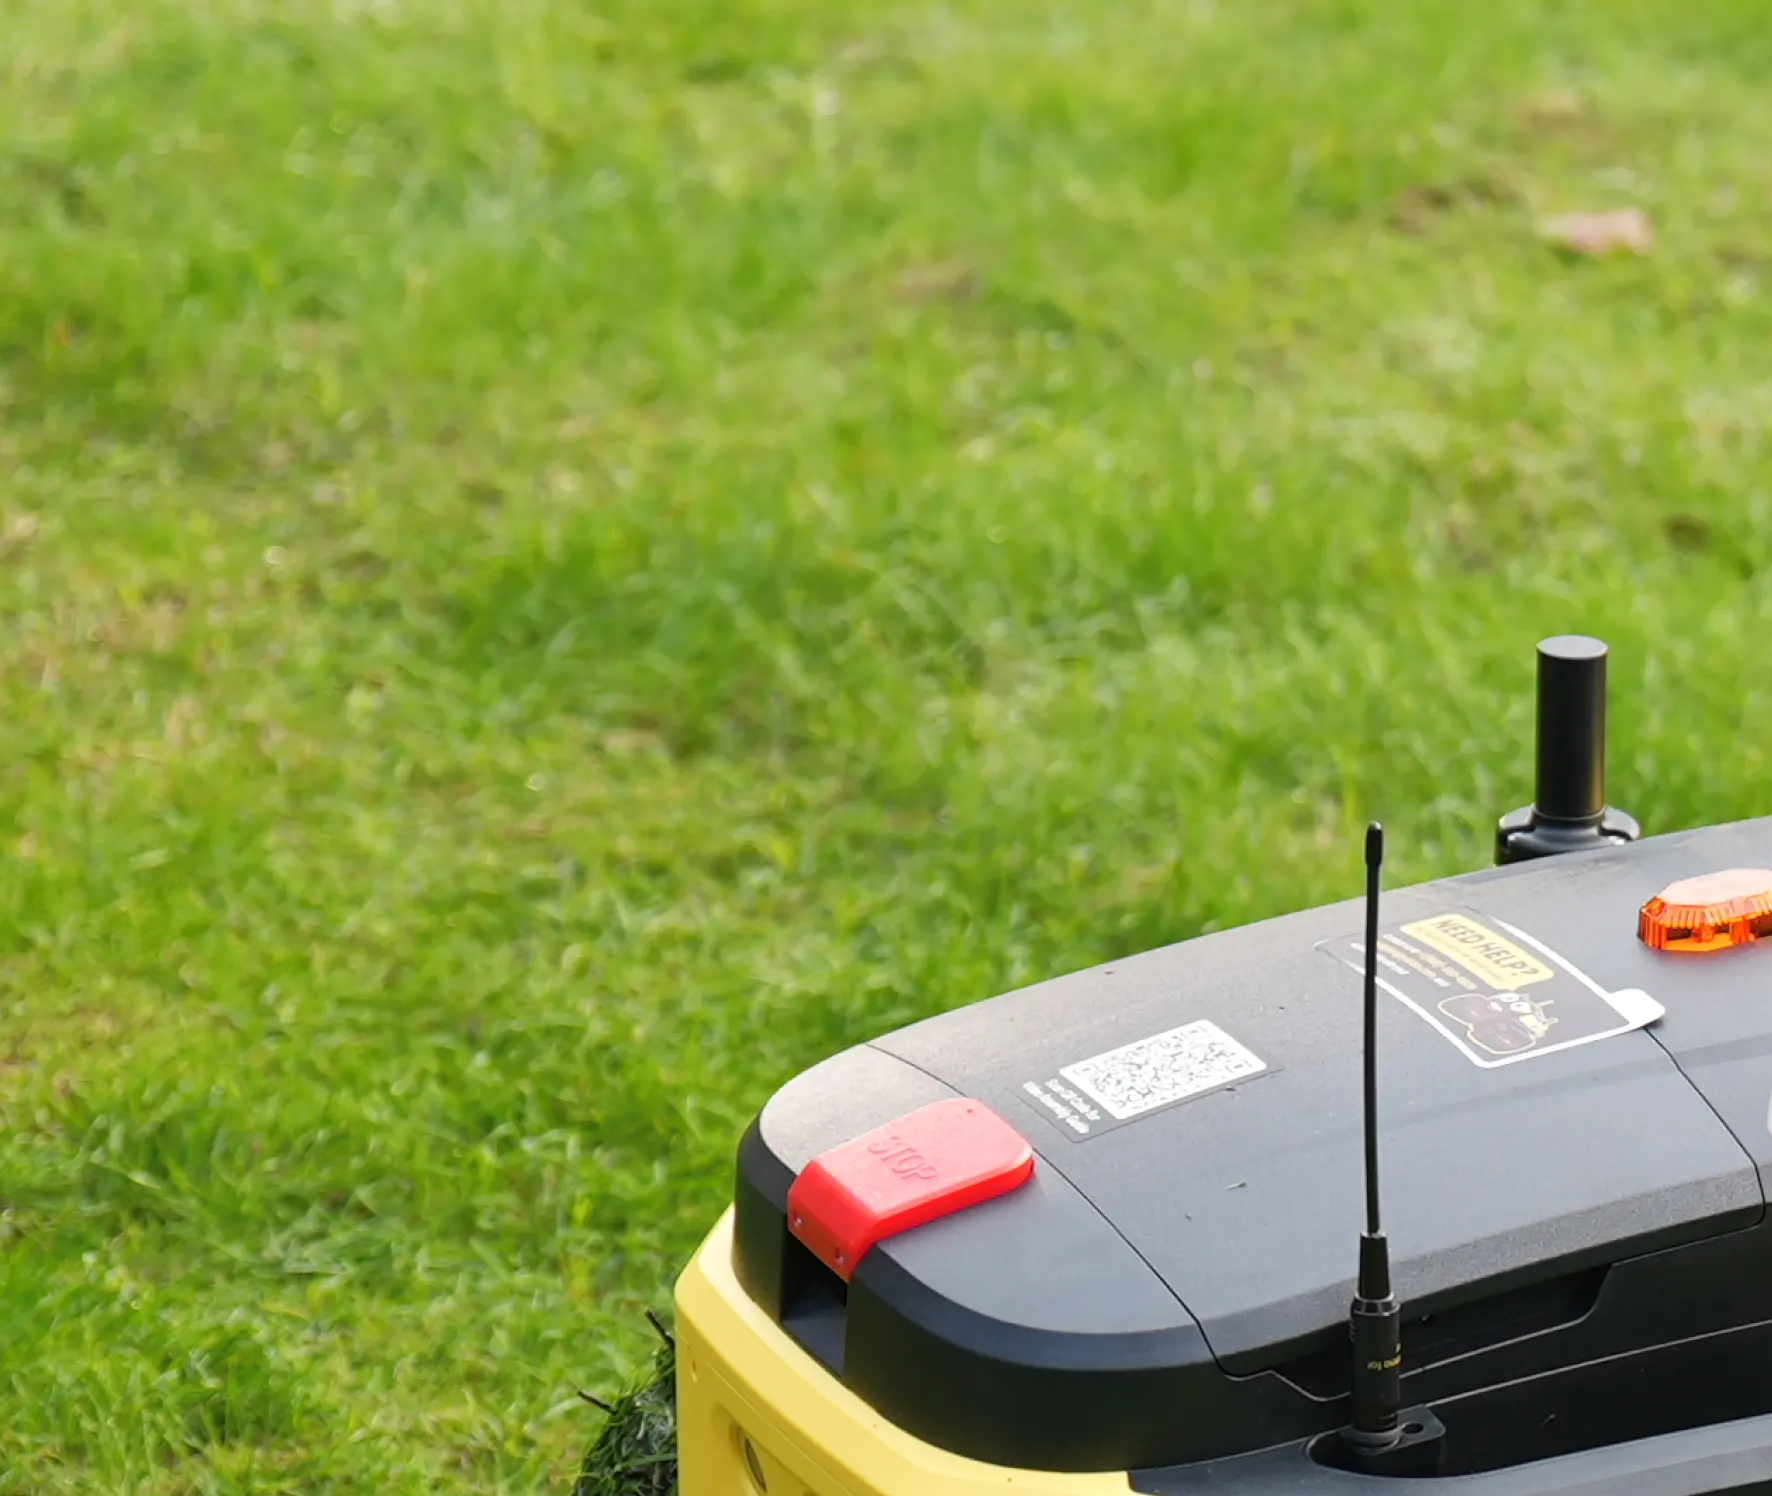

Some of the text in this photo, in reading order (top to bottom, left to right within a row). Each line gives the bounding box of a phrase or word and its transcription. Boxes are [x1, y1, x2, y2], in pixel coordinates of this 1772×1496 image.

[1428, 919, 1486, 944] NEED
[1470, 942, 1540, 976] HELP?
[867, 1135, 938, 1180] STOP
